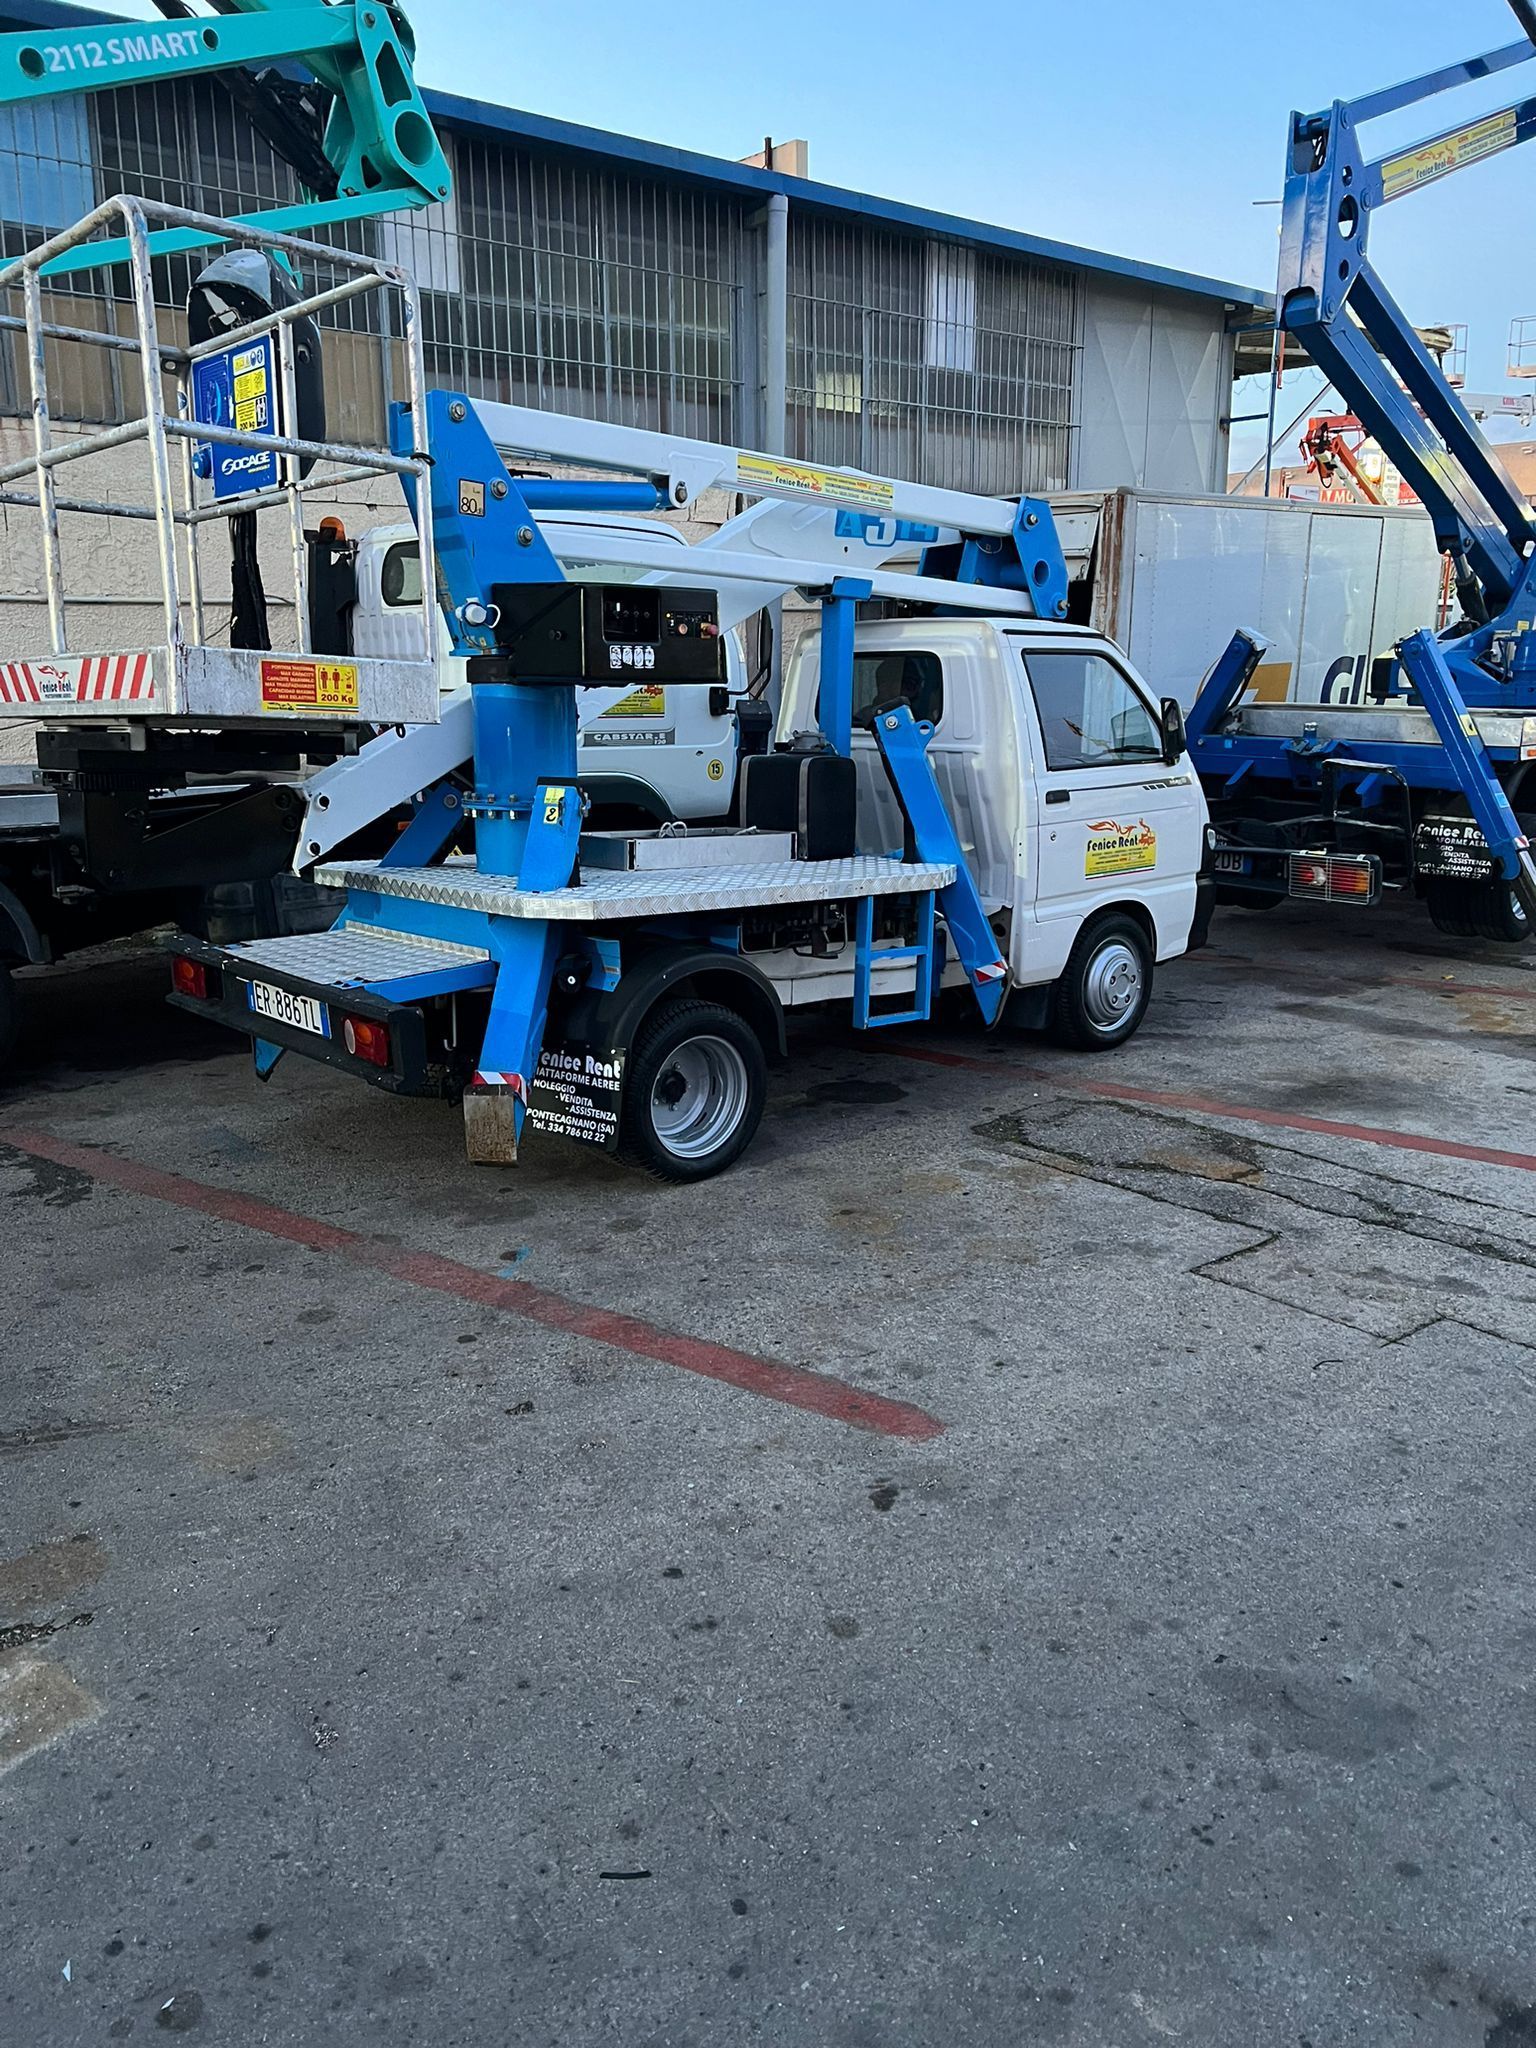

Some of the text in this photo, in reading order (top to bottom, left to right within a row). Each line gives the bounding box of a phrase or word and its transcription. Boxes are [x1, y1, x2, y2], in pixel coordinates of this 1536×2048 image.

[44, 30, 199, 72] 2112 SMART
[222, 451, 271, 476] SOCAGE
[321, 693, 354, 704] 200 Kg
[711, 763, 720, 775] 15
[1087, 838, 1117, 852] Fenice
[1118, 835, 1138, 848] Rent
[254, 983, 321, 1031] ER 886TL
[541, 1050, 621, 1079] enice Rent
[533, 1078, 576, 1094] NOLEGGIO
[536, 1066, 621, 1092] IATTAFORME AEREE
[525, 1107, 615, 1136] PONTECAGNANO (SA)
[532, 1119, 606, 1143] Tel. 334 786 02 22
